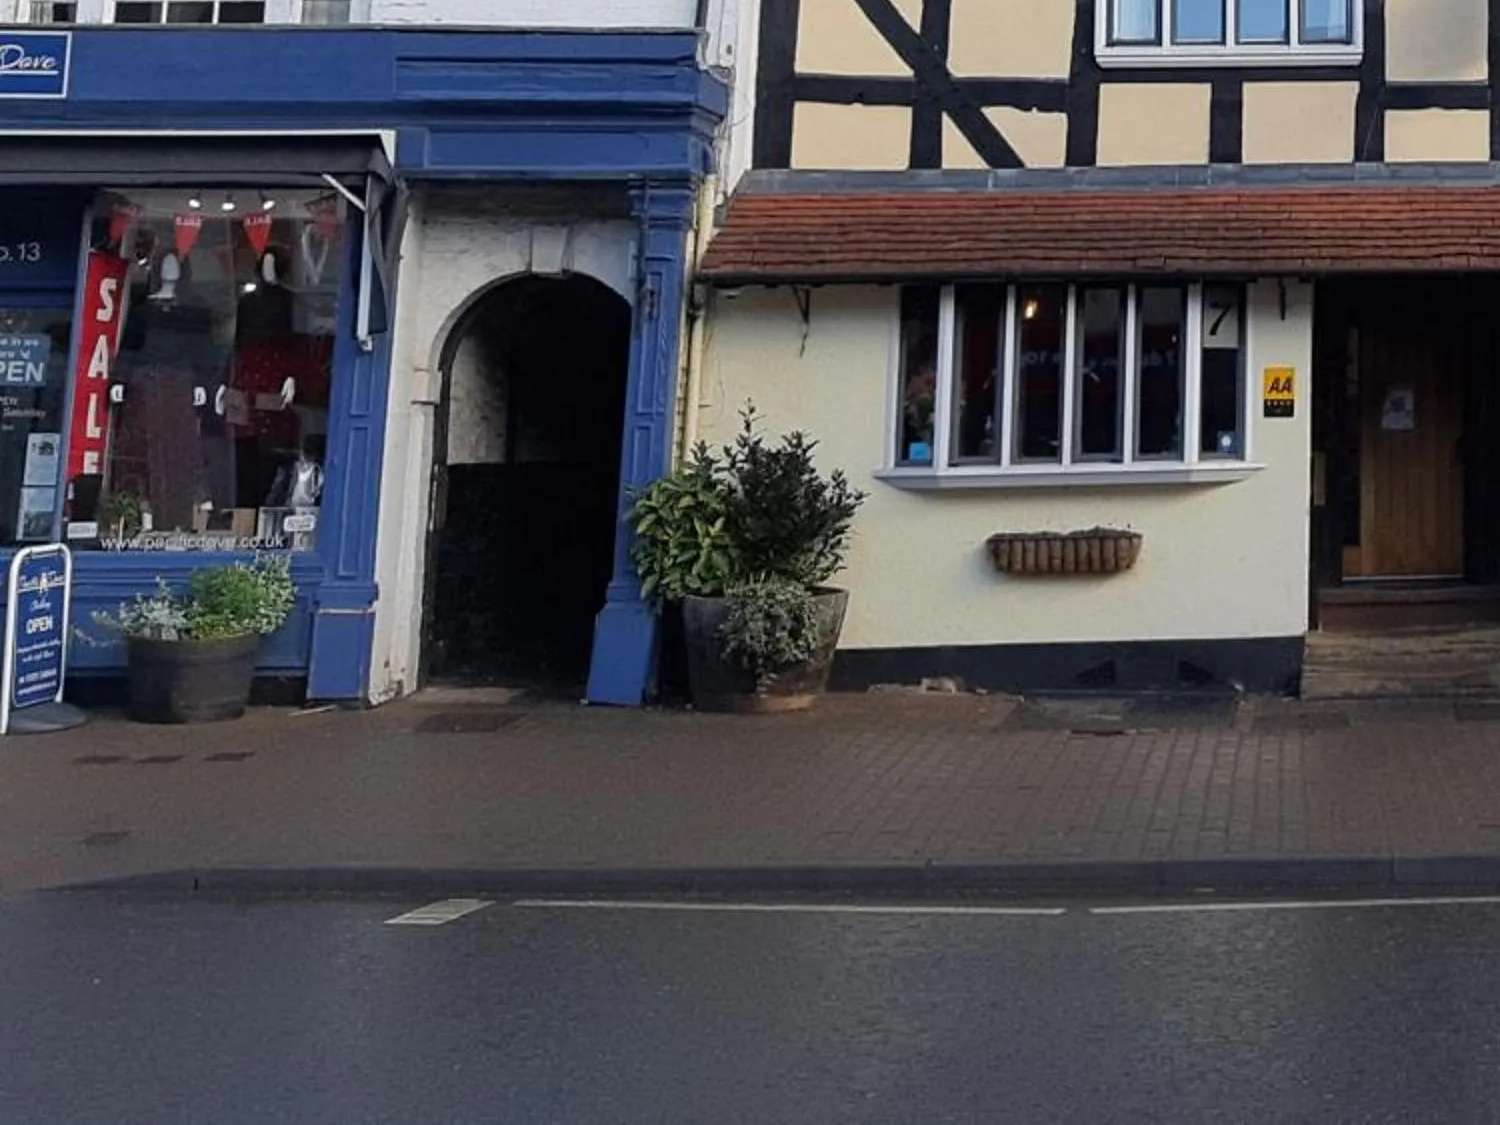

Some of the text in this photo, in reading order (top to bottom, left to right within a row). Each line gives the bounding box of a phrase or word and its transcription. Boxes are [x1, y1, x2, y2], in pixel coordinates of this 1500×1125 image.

[16, 241, 41, 261] 13
[1208, 300, 1233, 336] 7
[0, 360, 45, 383] EN
[1268, 376, 1293, 394] AA
[26, 615, 53, 635] OPEN
